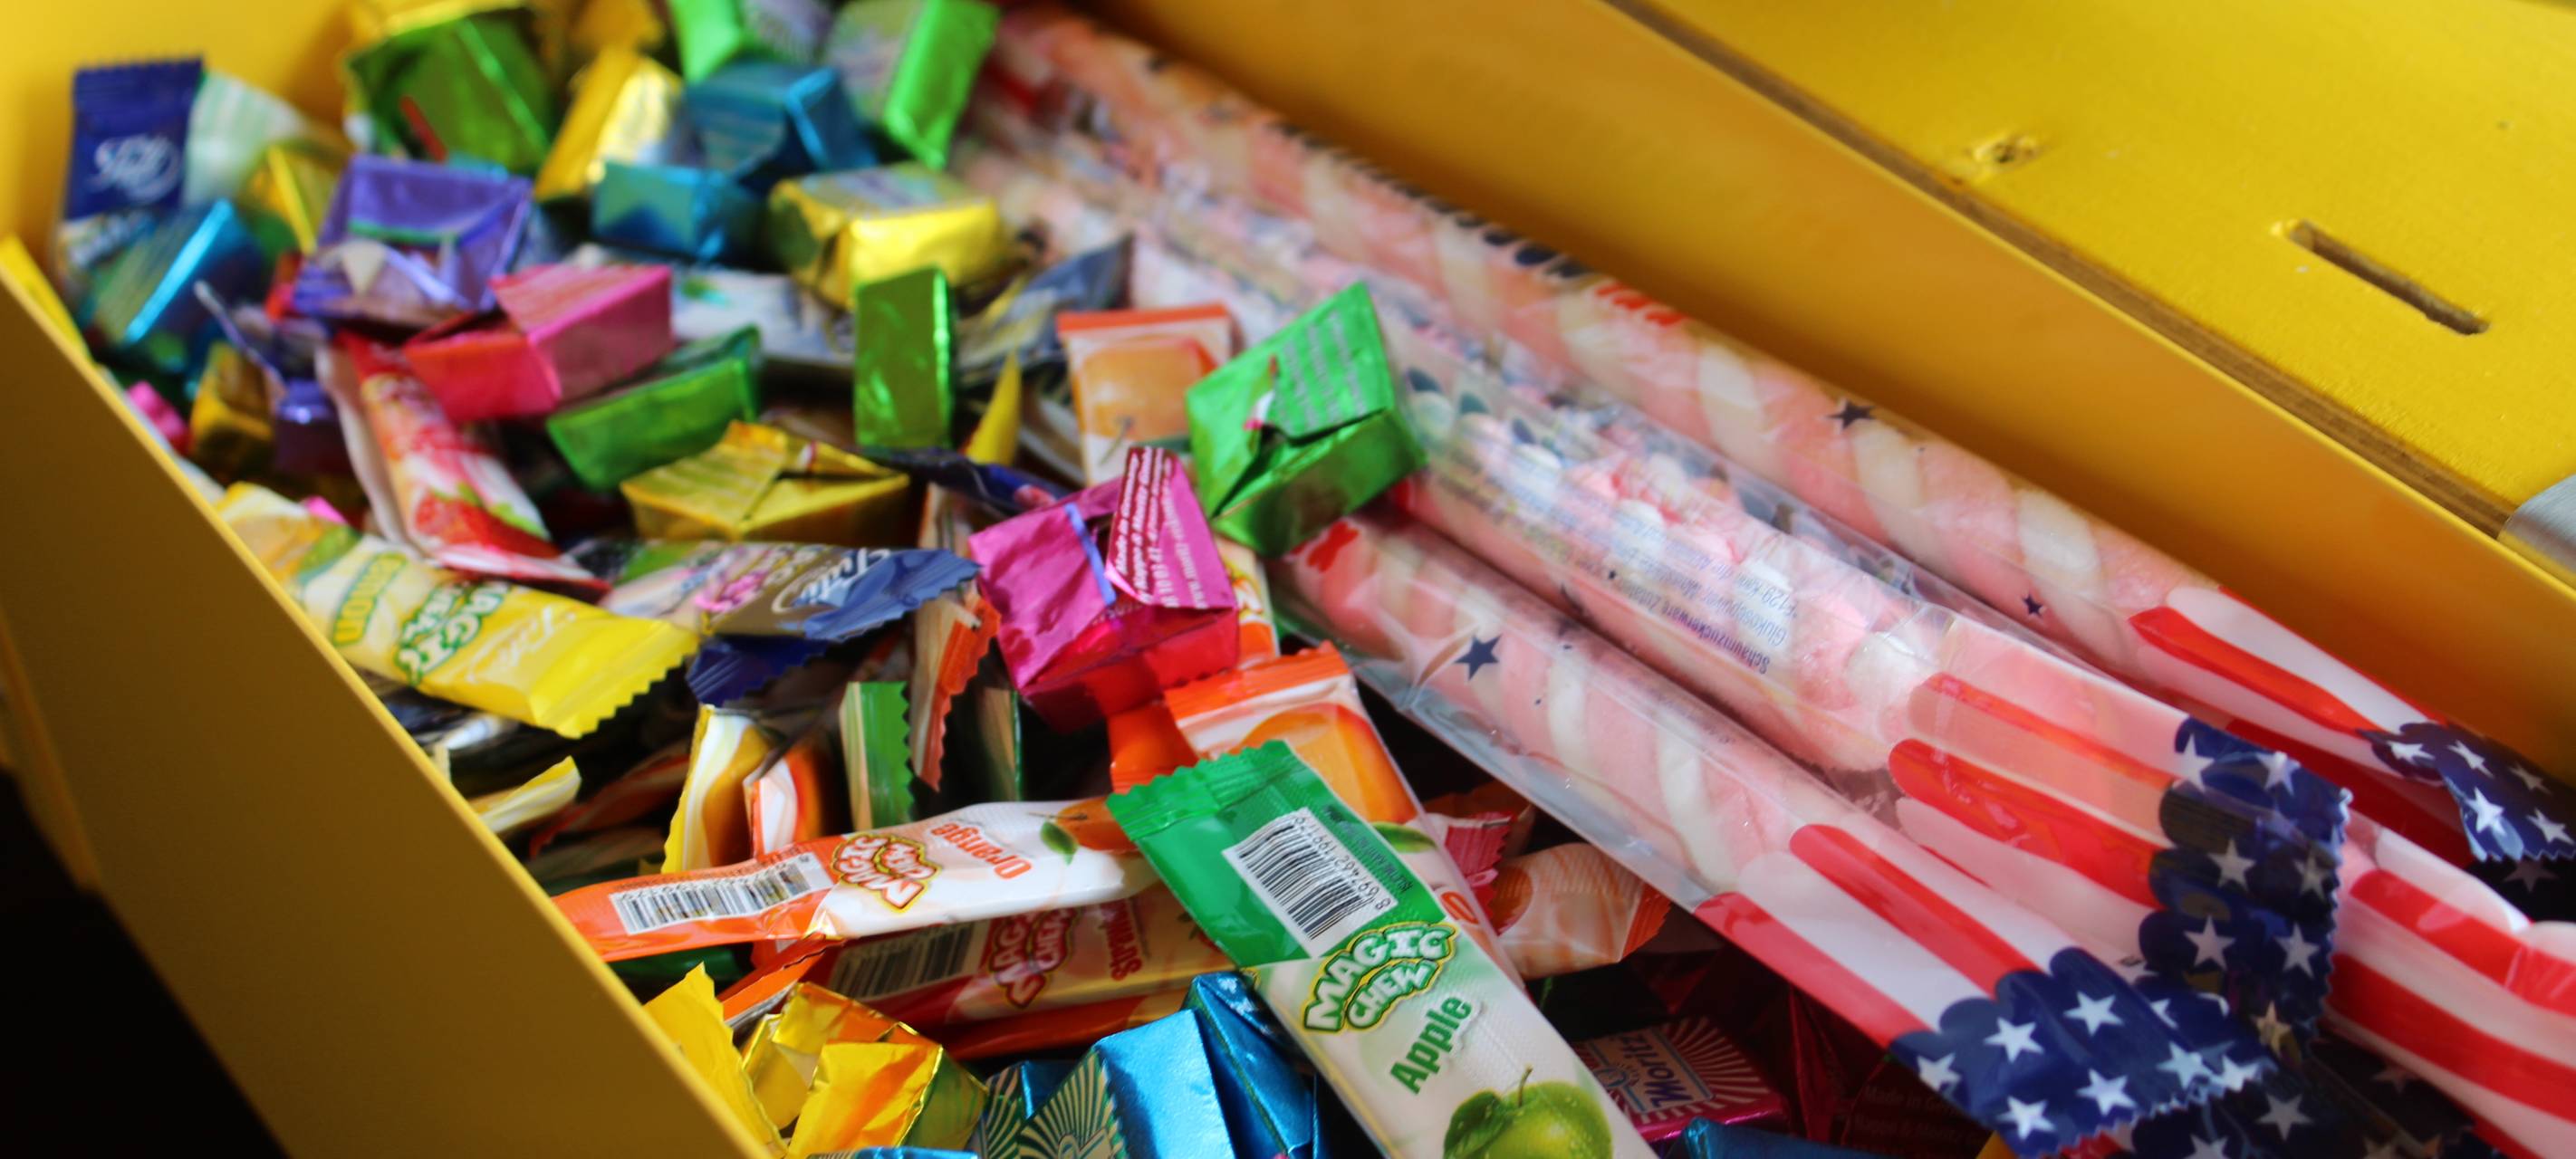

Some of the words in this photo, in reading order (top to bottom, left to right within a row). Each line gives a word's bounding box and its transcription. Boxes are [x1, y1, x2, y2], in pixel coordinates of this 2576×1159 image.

[834, 836, 926, 910] MAGIC
[931, 822, 1032, 880] Orange
[1304, 925, 1456, 1032] MAGIC
[1346, 958, 1441, 1030] CHEW
[1389, 995, 1473, 1095] Apple
[1621, 1034, 1694, 1107] Moritz
